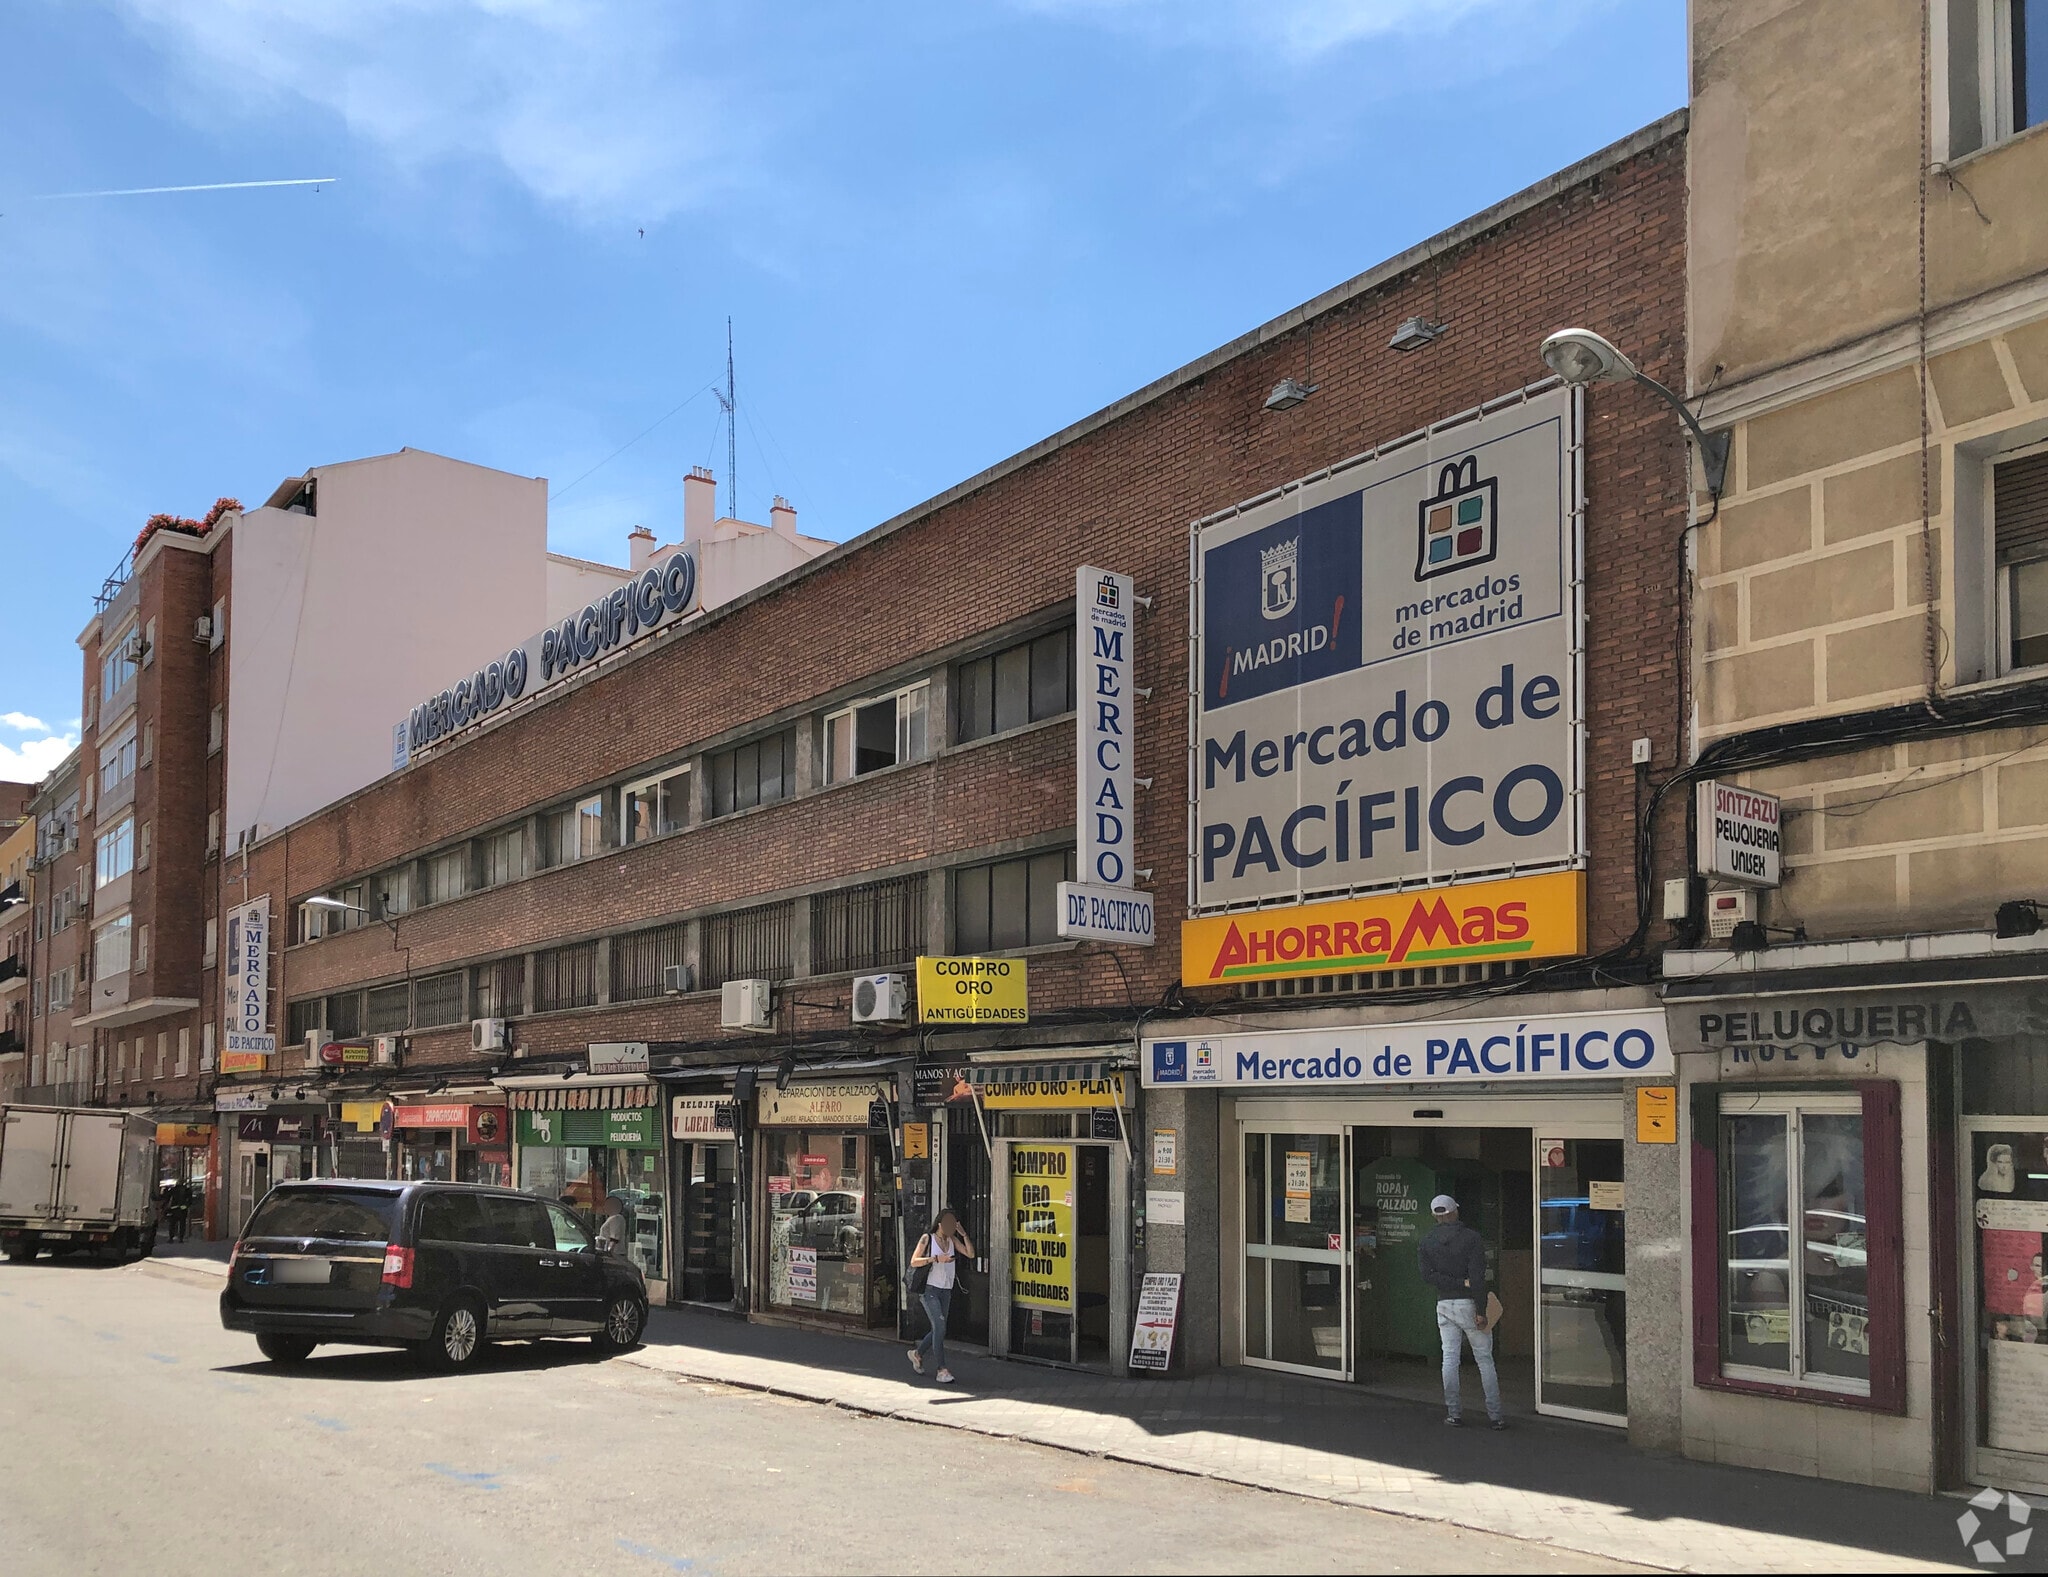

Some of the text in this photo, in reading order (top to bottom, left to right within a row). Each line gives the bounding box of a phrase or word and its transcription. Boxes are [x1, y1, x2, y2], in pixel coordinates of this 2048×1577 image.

[1395, 574, 1520, 624] mercados
[1091, 607, 1125, 620] mercados
[1091, 613, 1127, 628] de madrid
[1392, 595, 1523, 651] de madrid
[408, 551, 696, 751] MERCADO PACIFICO
[1219, 595, 1344, 698] ¡MADRID!
[1205, 663, 1561, 790] Mercado de
[1093, 626, 1124, 884] MERCADO
[1716, 788, 1778, 825] SINTZAZU
[1203, 764, 1564, 883] PACÍFICO
[1716, 817, 1780, 853] PELUQUERIA
[1731, 849, 1766, 877] UNISEX
[1068, 893, 1152, 935] DE PACIFICO
[936, 961, 1010, 976] COMPRO
[245, 930, 262, 1032] MERCADO
[955, 980, 993, 995] ORO
[926, 1005, 1026, 1019] ANTIGÜEDADES
[1700, 1001, 1979, 1042] PELUQUERIA
[229, 1035, 274, 1051] DE PACIFICO
[1236, 1024, 1655, 1080] Mercado de PACÍFICO
[915, 1068, 944, 1080] MANOS
[945, 1068, 951, 1078] Y
[827, 1086, 837, 1097] DE
[839, 1085, 878, 1097] CALZADO
[985, 1081, 1037, 1096] COMPRO
[1040, 1080, 1068, 1095] ORO
[1080, 1077, 1123, 1095] PLATA
[610, 1112, 643, 1122] PRODUCTOS
[809, 1101, 842, 1113] ALFARO
[1010, 1151, 1067, 1175] COMPRO
[1022, 1184, 1051, 1208] ORO
[1376, 1182, 1402, 1194] ROPA
[1377, 1199, 1418, 1211] CALZADO
[1016, 1209, 1057, 1235] PLATA
[1041, 1240, 1067, 1258] VIEJO
[1020, 1256, 1053, 1275] Y ROTO
